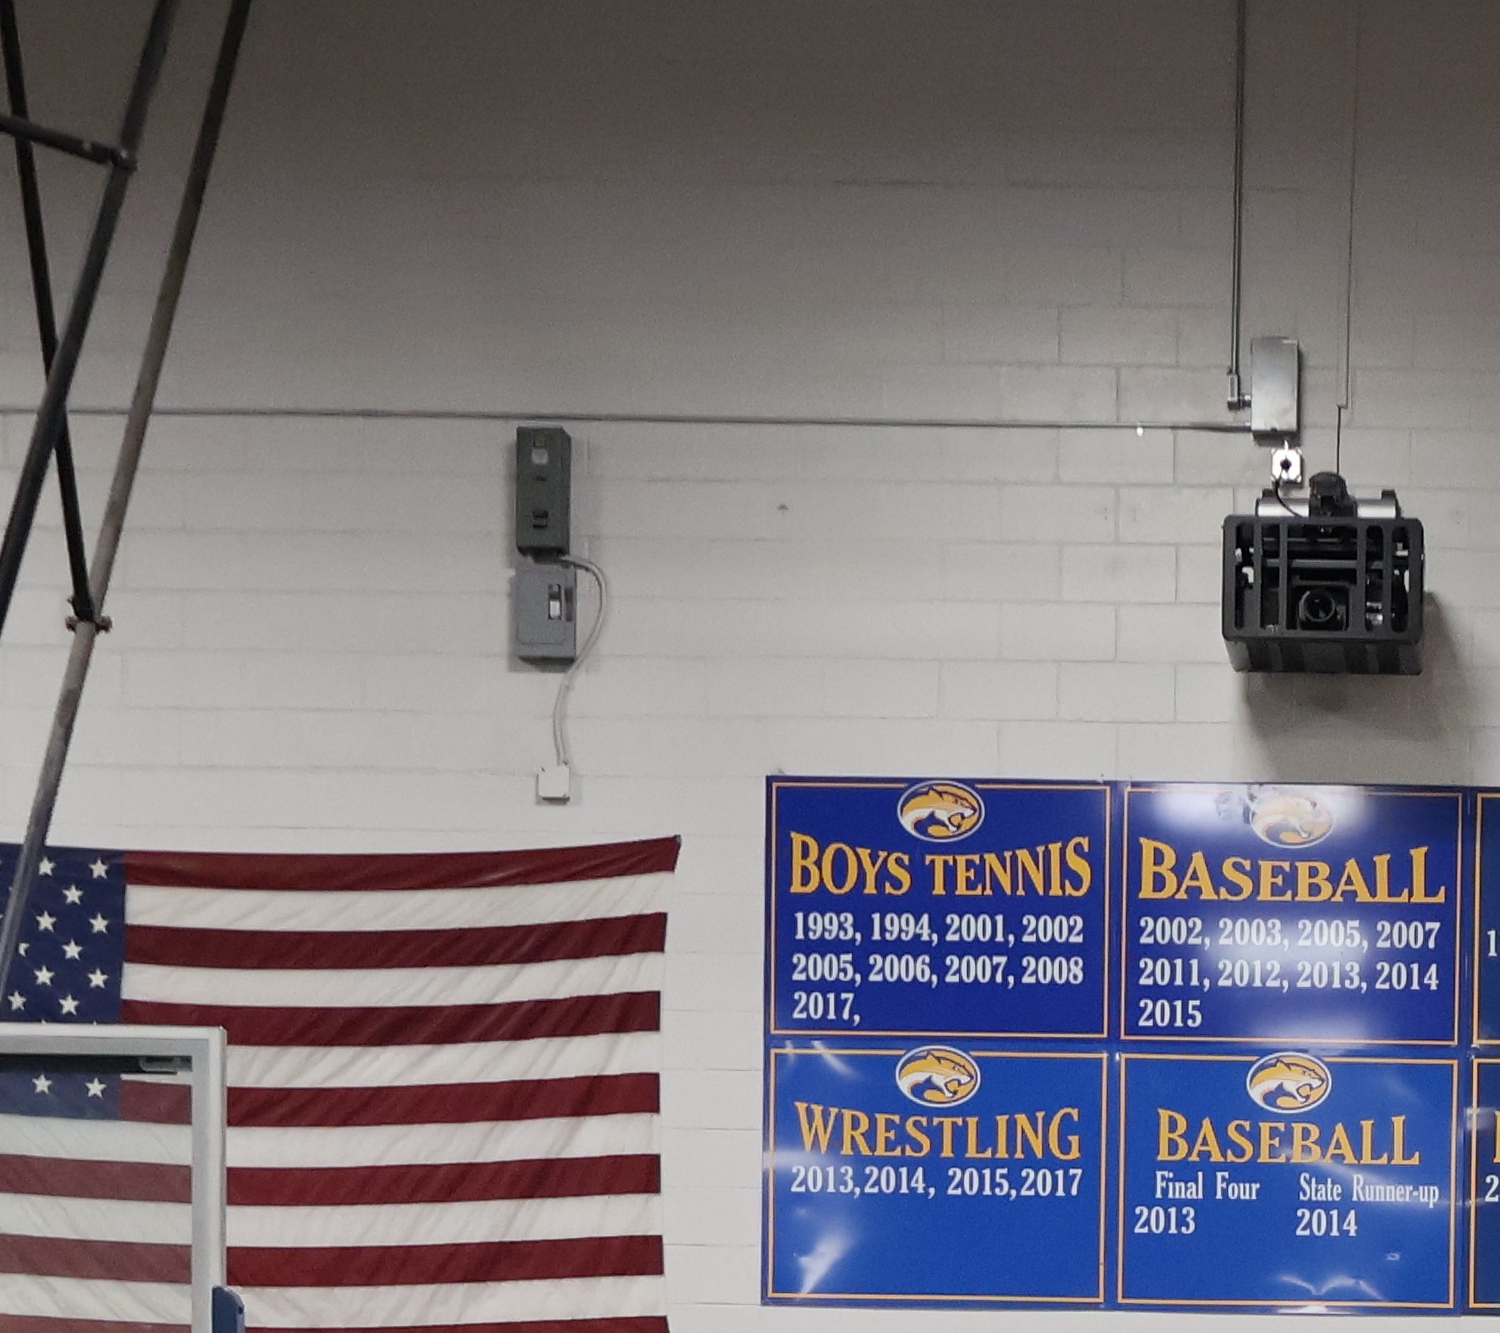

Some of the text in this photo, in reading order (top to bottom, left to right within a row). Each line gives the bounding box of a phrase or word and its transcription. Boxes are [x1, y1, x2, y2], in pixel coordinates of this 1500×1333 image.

[790, 832, 1092, 899] BOYS TENNIS
[1139, 837, 1445, 903] BASEBALL
[795, 912, 1083, 947] 1993, 1994, 2001, 2002
[1139, 917, 1441, 953] 2002, 2003, 2005, 2007
[792, 953, 1083, 989] 2005, 2006, 2007, 2008
[1139, 958, 1438, 994] 2011, 2012, 2013, 2014
[793, 992, 860, 1026] 2017,
[1139, 999, 1201, 1027] 2015
[795, 1101, 1081, 1160] WRESTLING
[1156, 1108, 1420, 1166] BASEBALL
[1155, 1173, 1260, 1201] Final Four
[1299, 1173, 1439, 1208] State Runner-up
[1134, 1206, 1195, 1234] 2013
[1296, 1209, 1357, 1236] 2014
